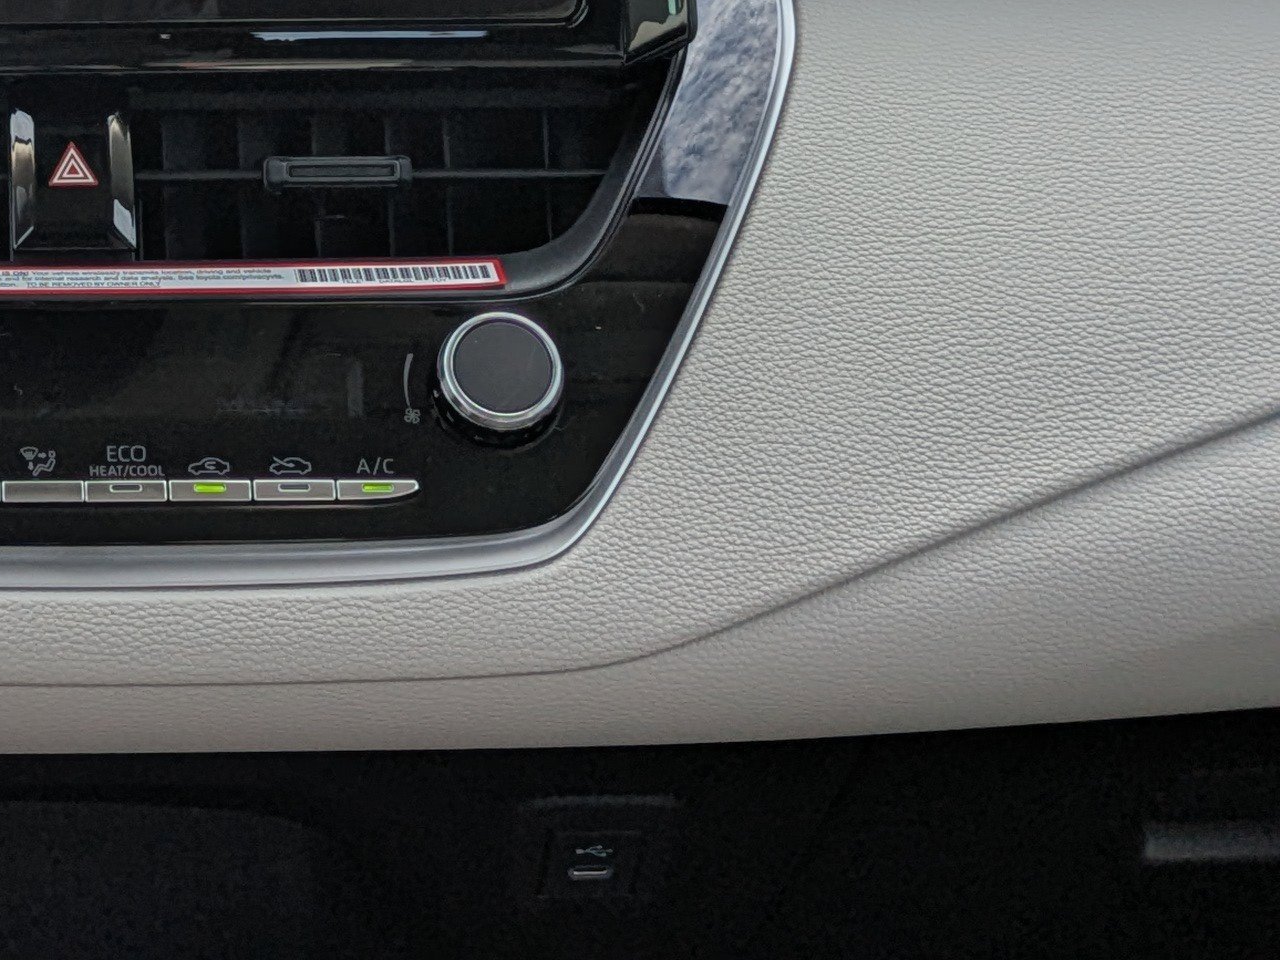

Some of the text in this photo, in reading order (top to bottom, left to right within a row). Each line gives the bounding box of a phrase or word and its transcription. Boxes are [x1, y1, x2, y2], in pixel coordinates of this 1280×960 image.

[106, 445, 147, 463] ECO
[89, 465, 165, 477] HEAT/COOL
[356, 458, 395, 475] A/C
